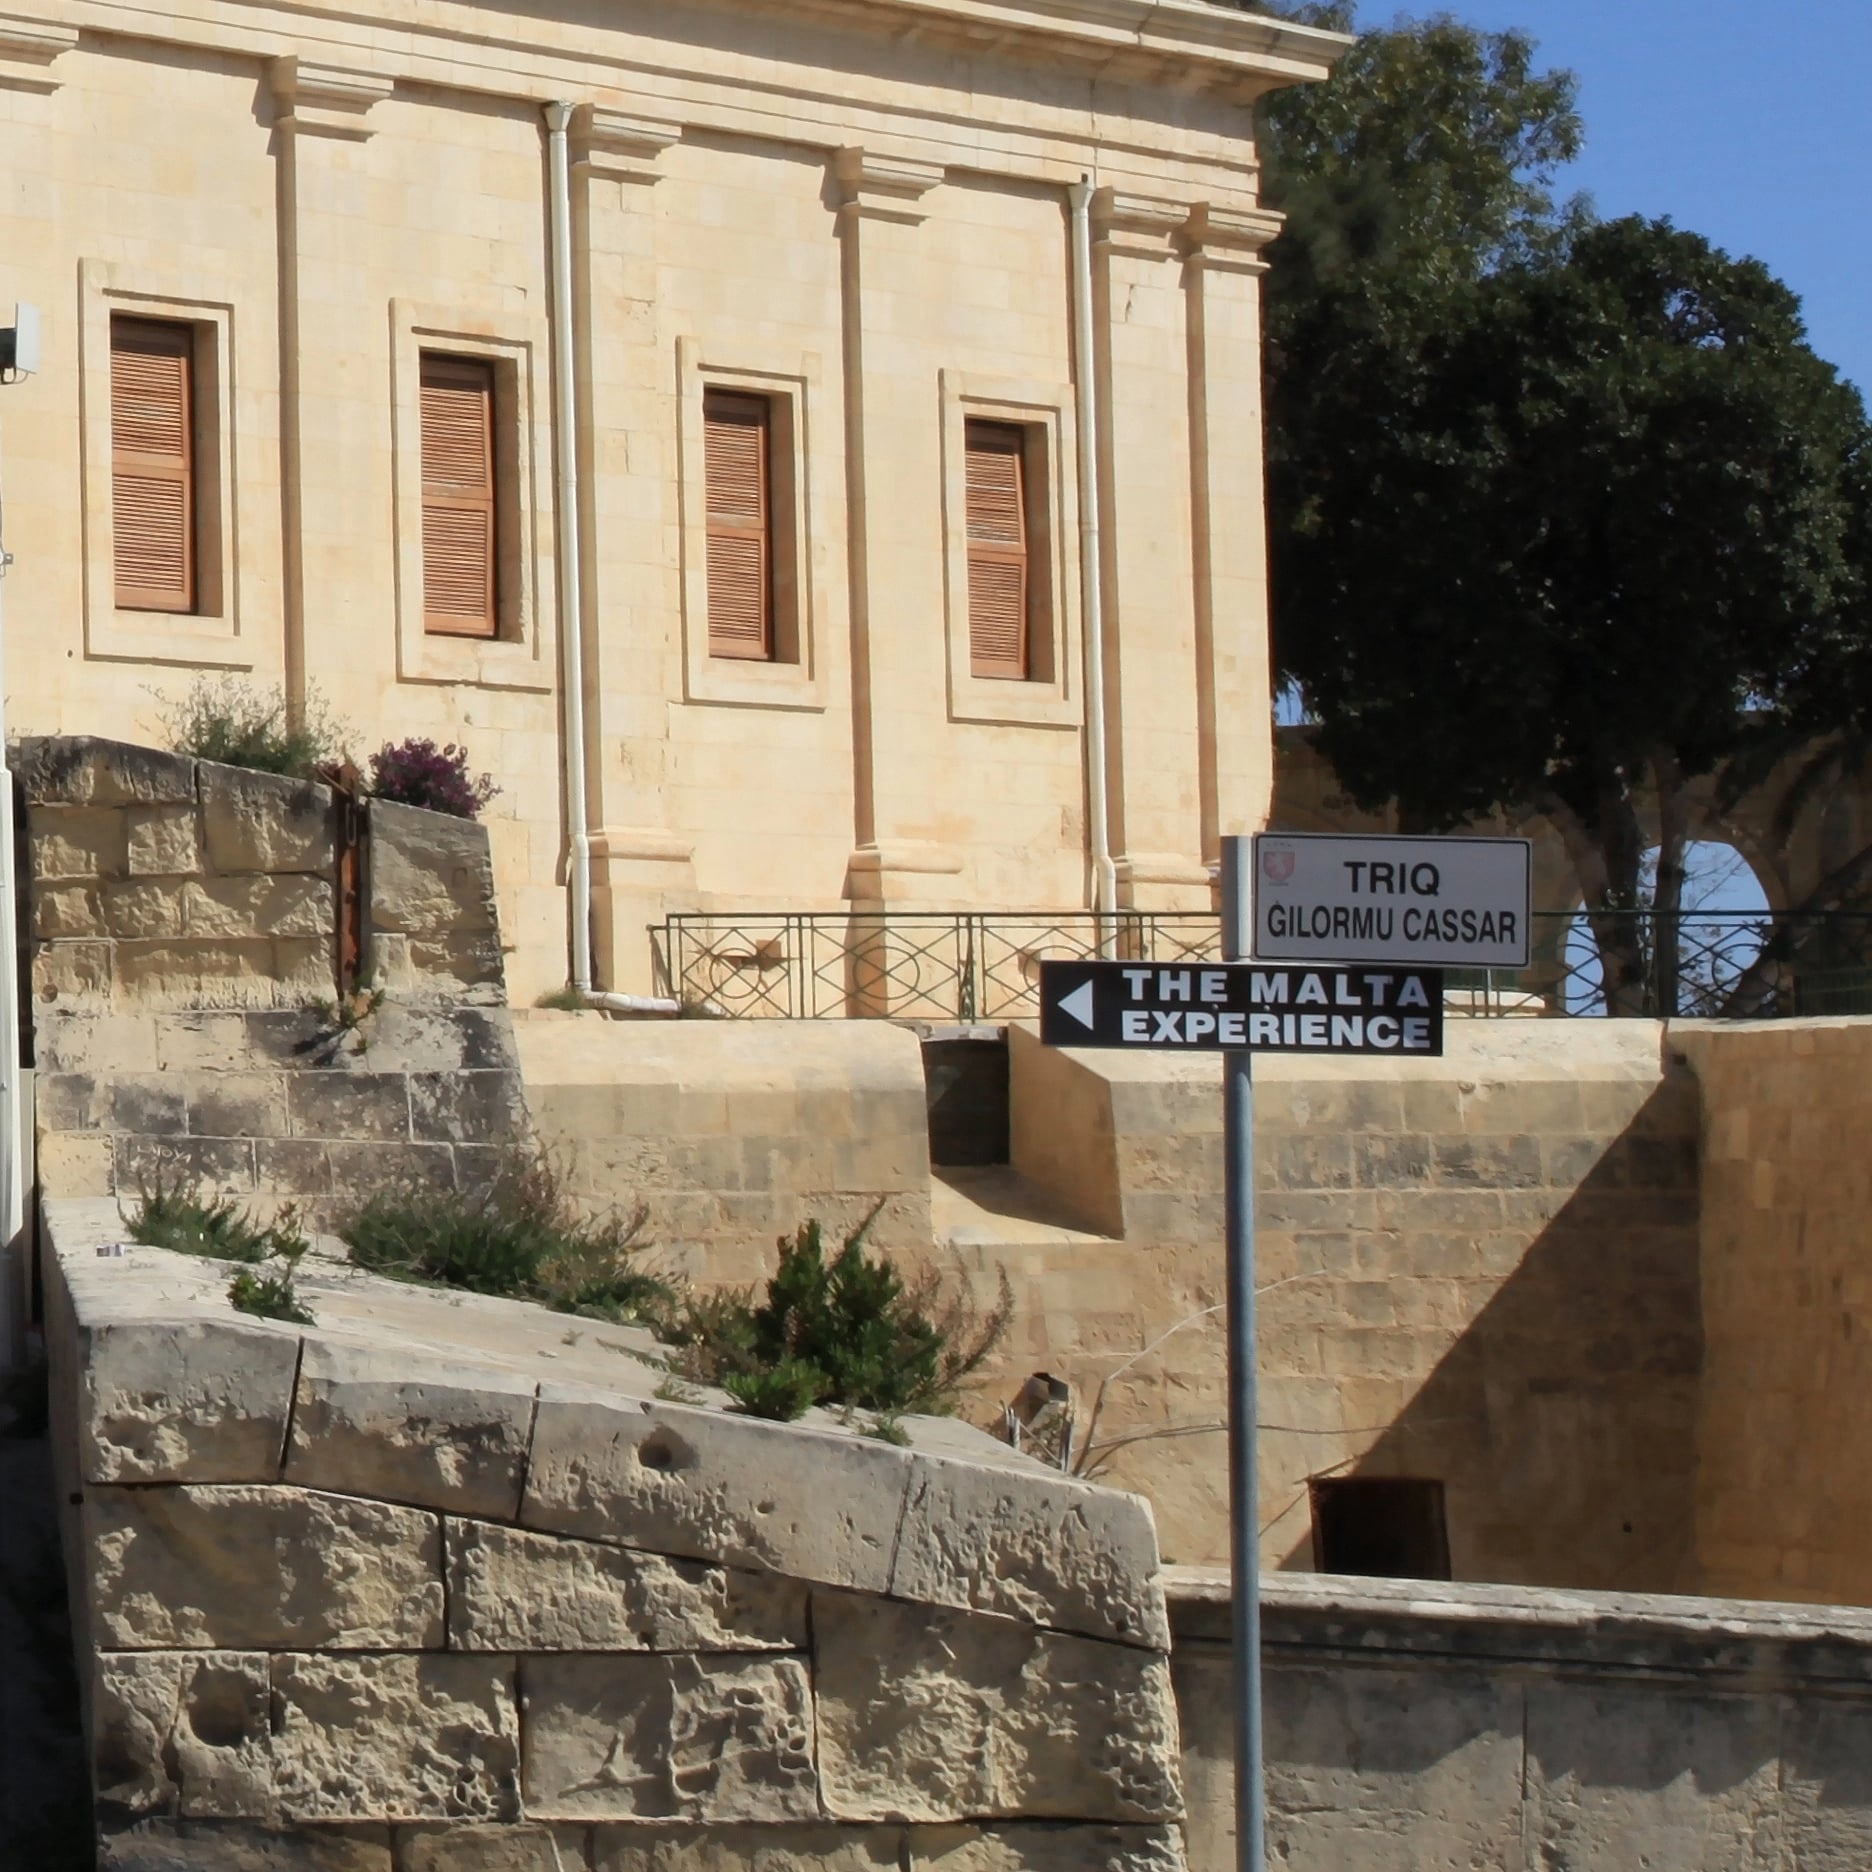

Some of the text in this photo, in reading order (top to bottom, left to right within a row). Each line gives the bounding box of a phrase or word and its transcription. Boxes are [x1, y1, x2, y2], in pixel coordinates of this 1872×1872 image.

[1344, 861, 1440, 897] TRIQ
[1267, 900, 1516, 944] ĠILORMU CASSAR
[1122, 969, 1430, 1007] THE MALTA
[1121, 1010, 1431, 1049] EXPERIENCE
